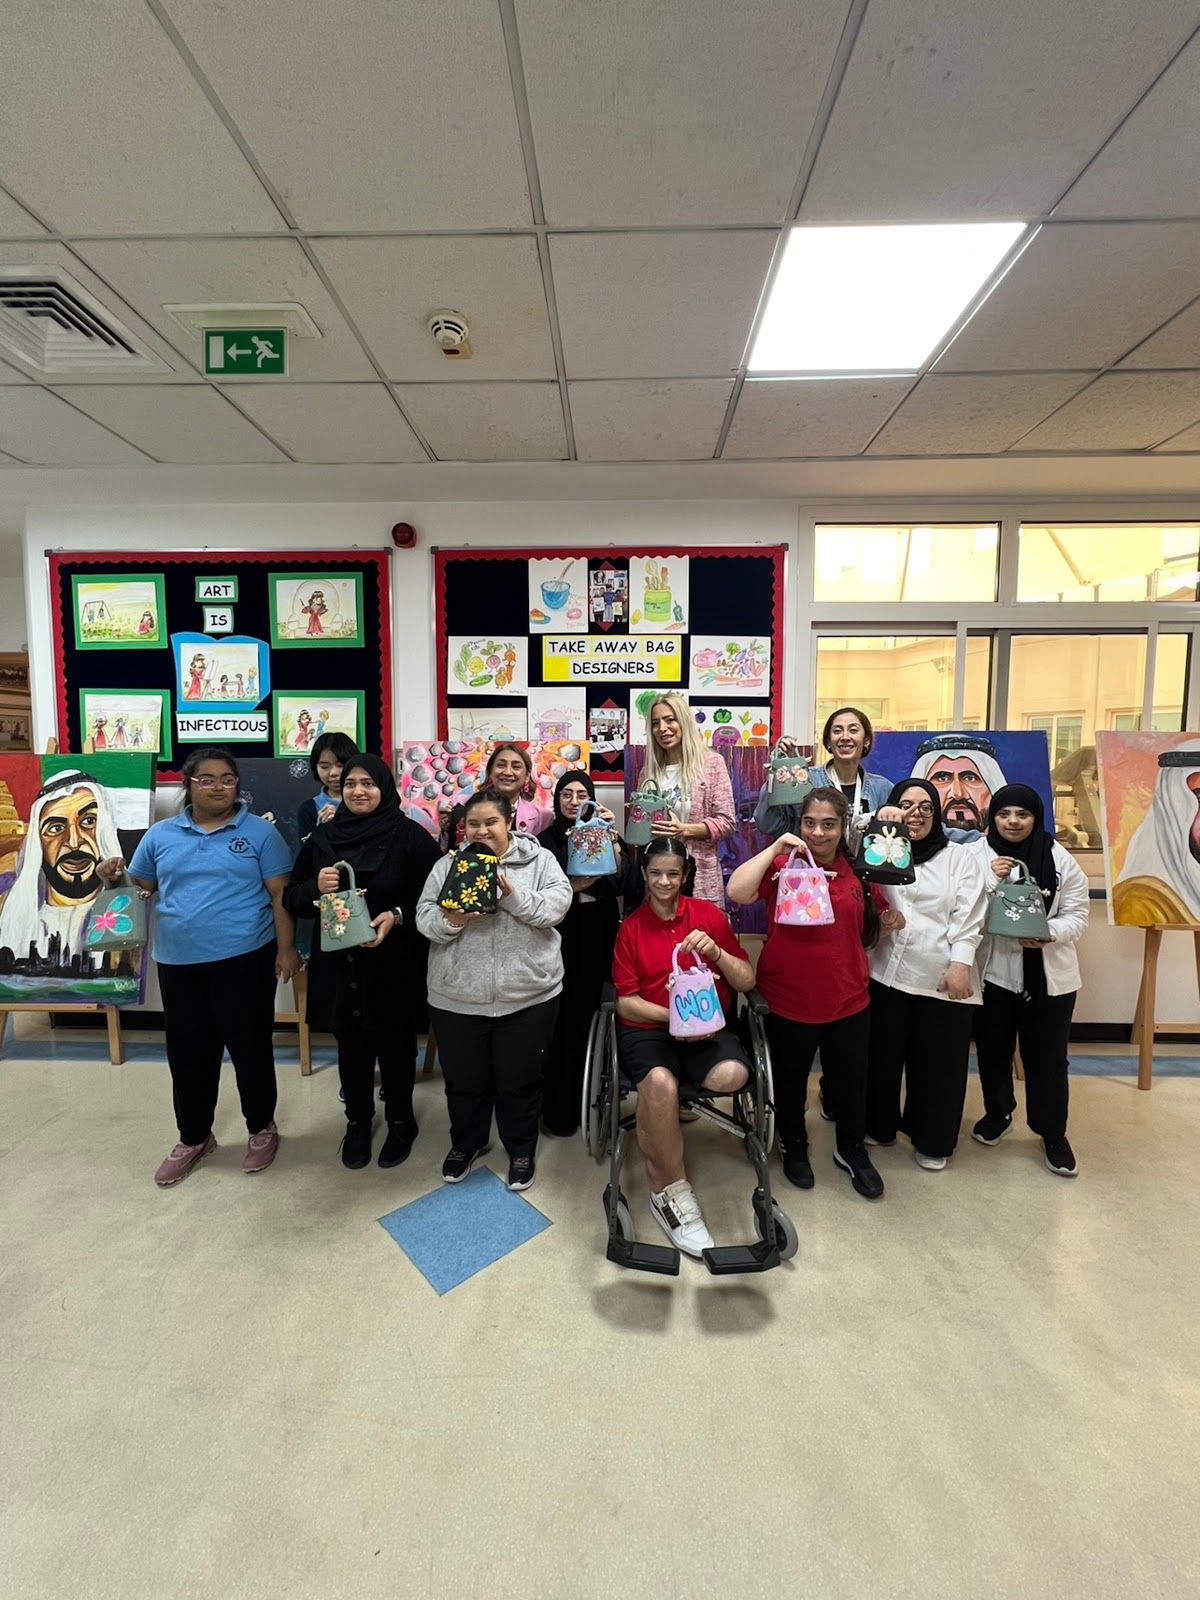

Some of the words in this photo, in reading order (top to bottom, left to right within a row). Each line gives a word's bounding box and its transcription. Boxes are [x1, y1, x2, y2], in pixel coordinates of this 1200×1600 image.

[203, 585, 231, 597] ART
[210, 615, 228, 626] IS
[548, 640, 586, 653] TAKE
[594, 640, 638, 653] AWAY
[646, 640, 675, 653] BAG
[572, 661, 655, 675] DESIGNERS
[178, 719, 268, 732] INFECTIOUS
